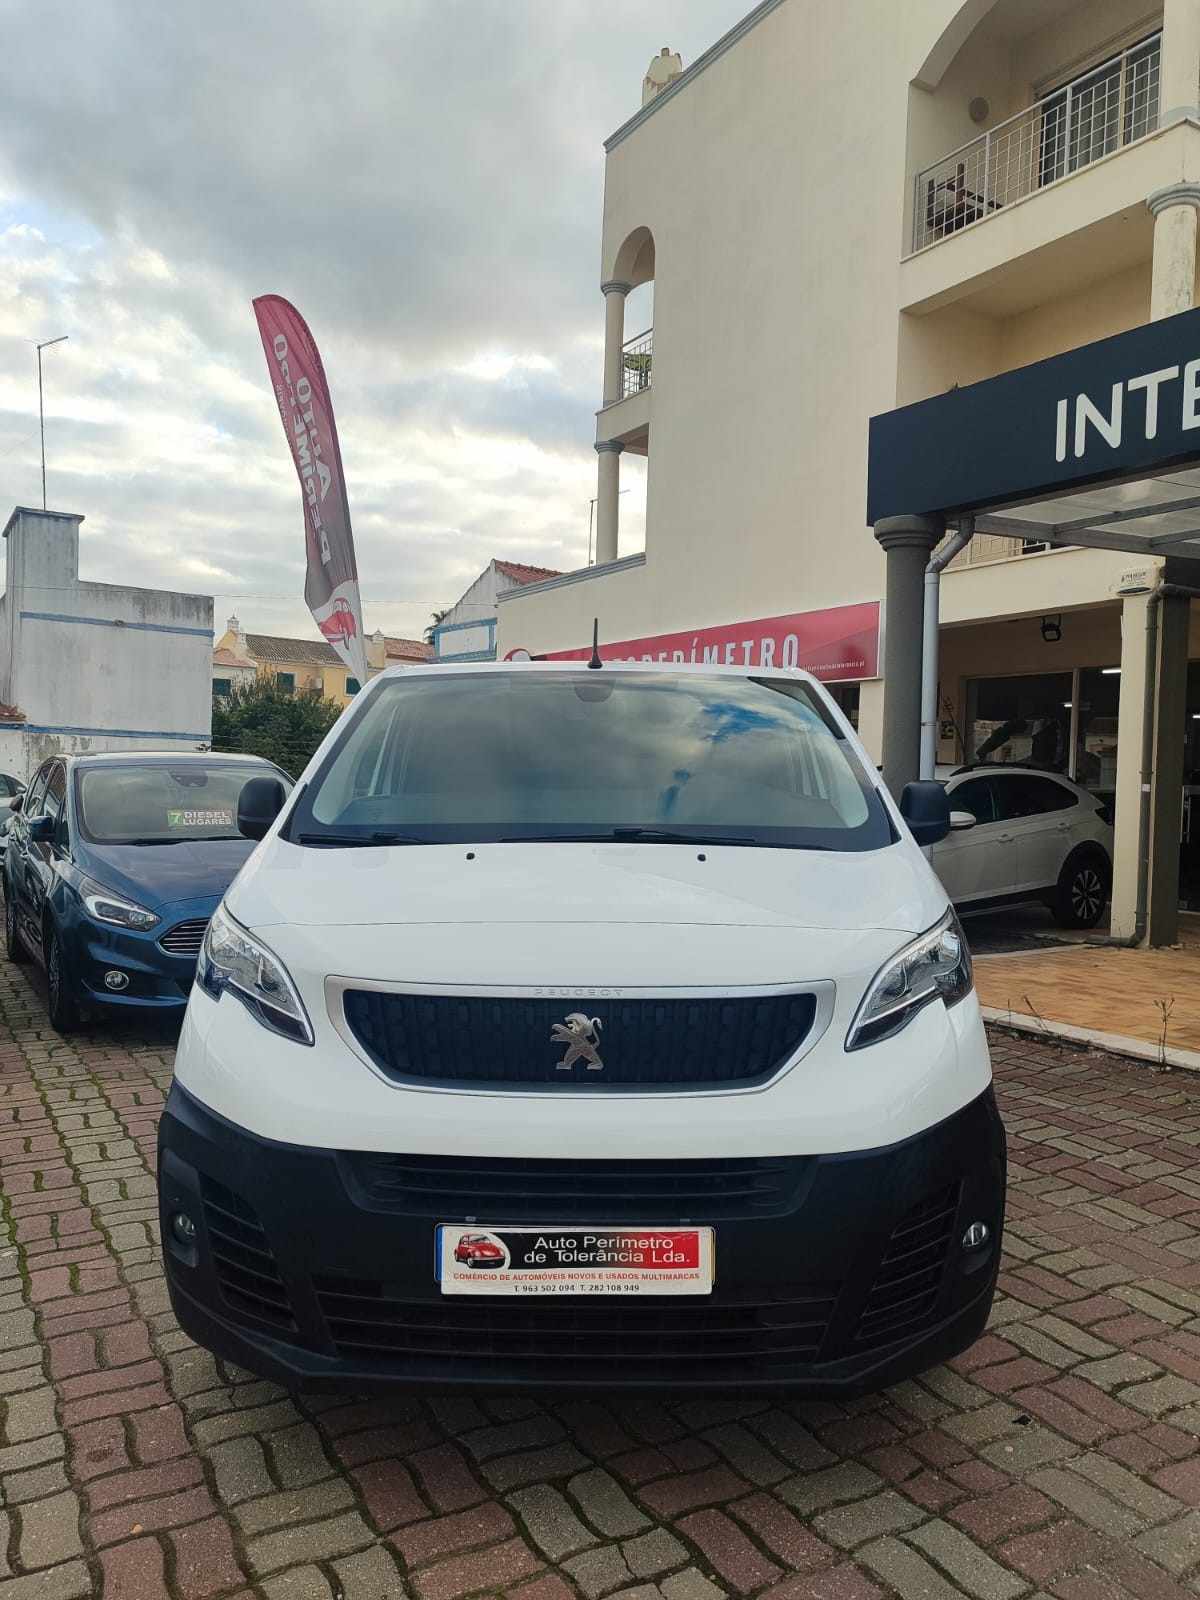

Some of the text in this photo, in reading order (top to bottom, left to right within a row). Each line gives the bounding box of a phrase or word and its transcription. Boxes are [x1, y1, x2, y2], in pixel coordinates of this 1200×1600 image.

[535, 988, 623, 996] PEUGEOT
[534, 1236, 577, 1249] Auto
[524, 1249, 690, 1263] de Tolerância Lda.
